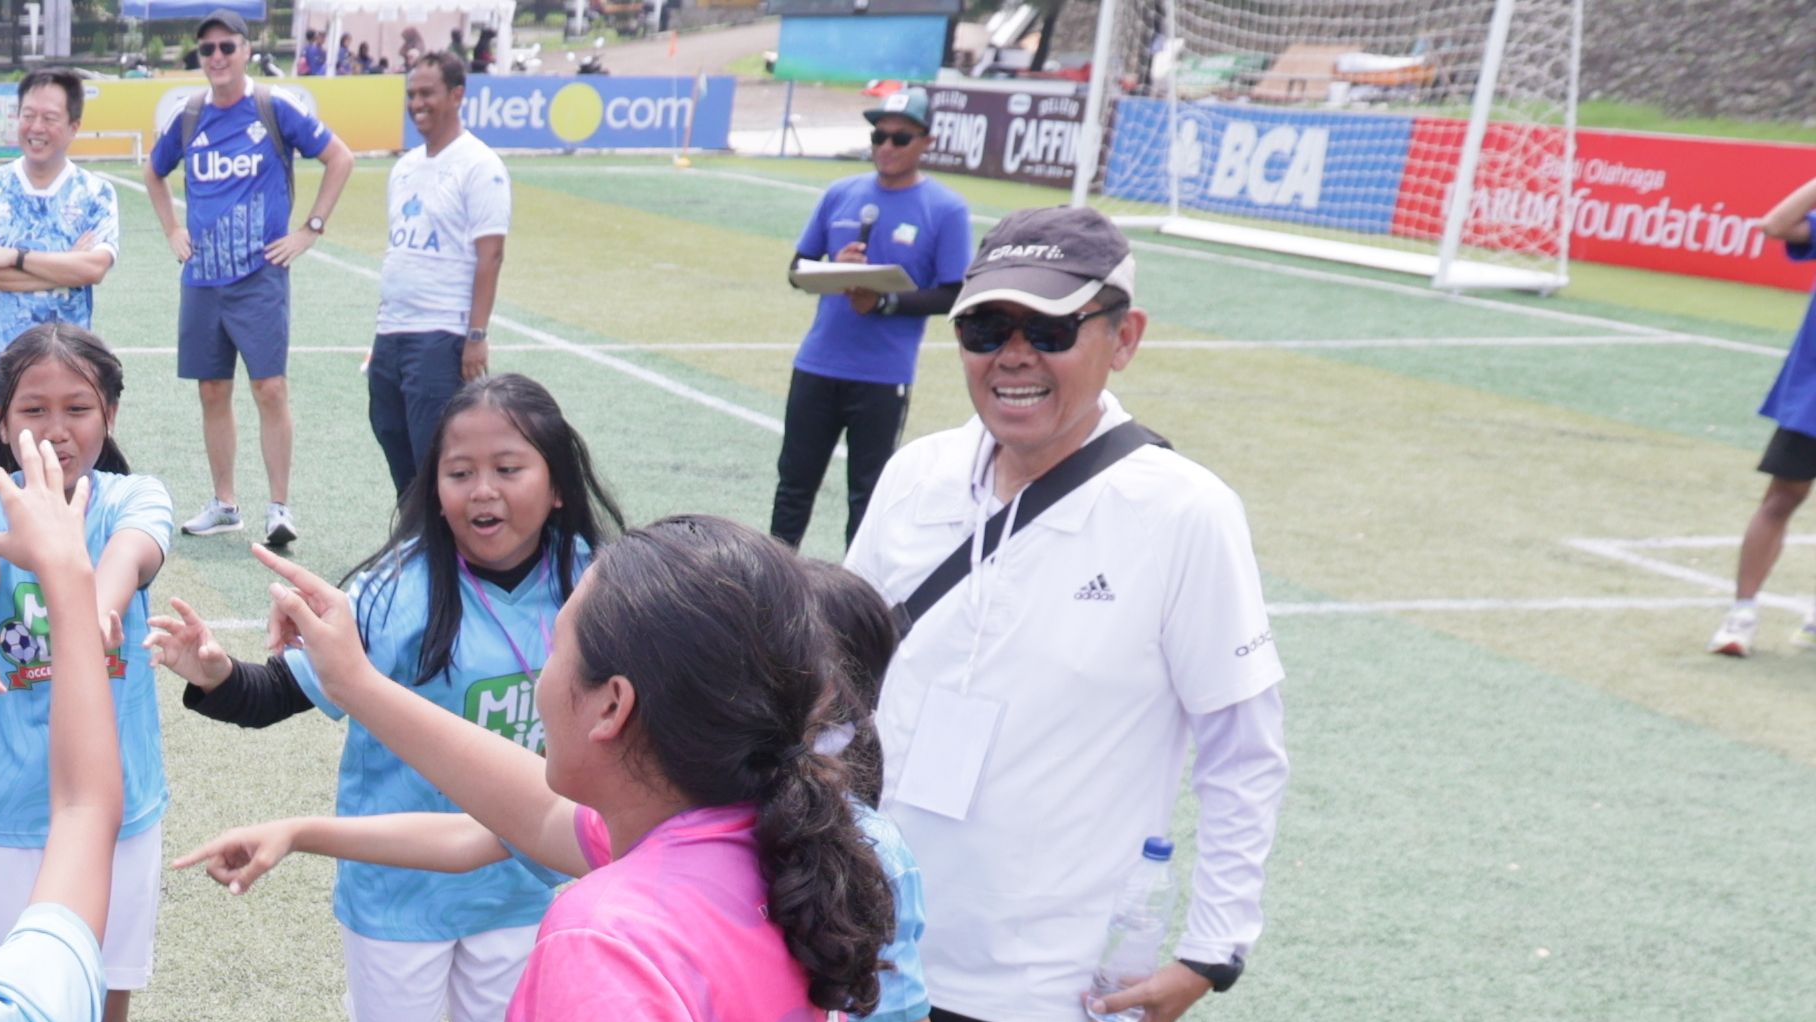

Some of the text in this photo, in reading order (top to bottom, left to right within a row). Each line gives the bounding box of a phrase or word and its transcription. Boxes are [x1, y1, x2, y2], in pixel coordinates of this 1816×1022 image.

[192, 151, 264, 181] Uber
[1003, 117, 1083, 175] CAFFIN
[1207, 120, 1331, 208] BCA
[1565, 188, 1767, 258] foundation
[477, 680, 540, 727] Mil
